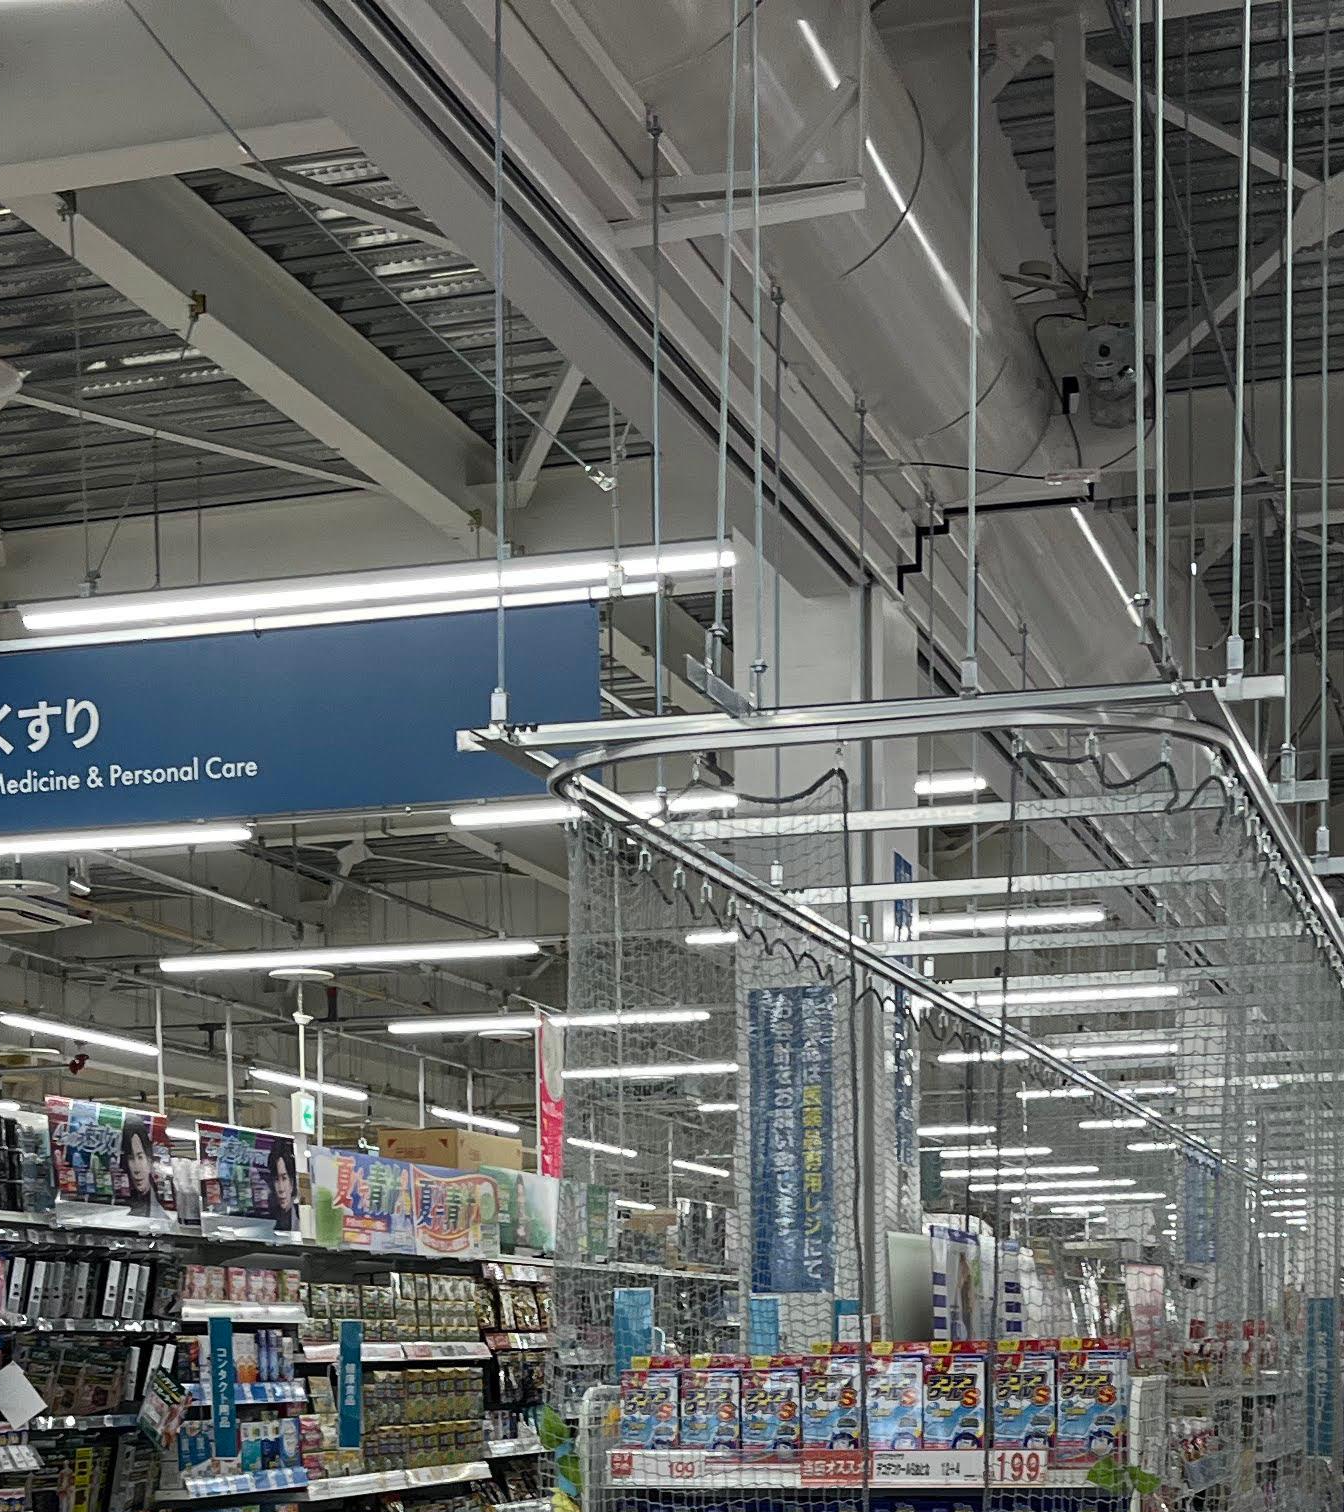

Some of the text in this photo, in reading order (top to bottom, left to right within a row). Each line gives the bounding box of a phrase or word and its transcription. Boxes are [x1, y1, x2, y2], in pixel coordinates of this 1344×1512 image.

[87, 766, 105, 788] &
[110, 758, 199, 791] Personal
[204, 756, 258, 779] Care
[216, 1348, 231, 1428] コンタクト用品
[995, 1452, 1041, 1482] 199
